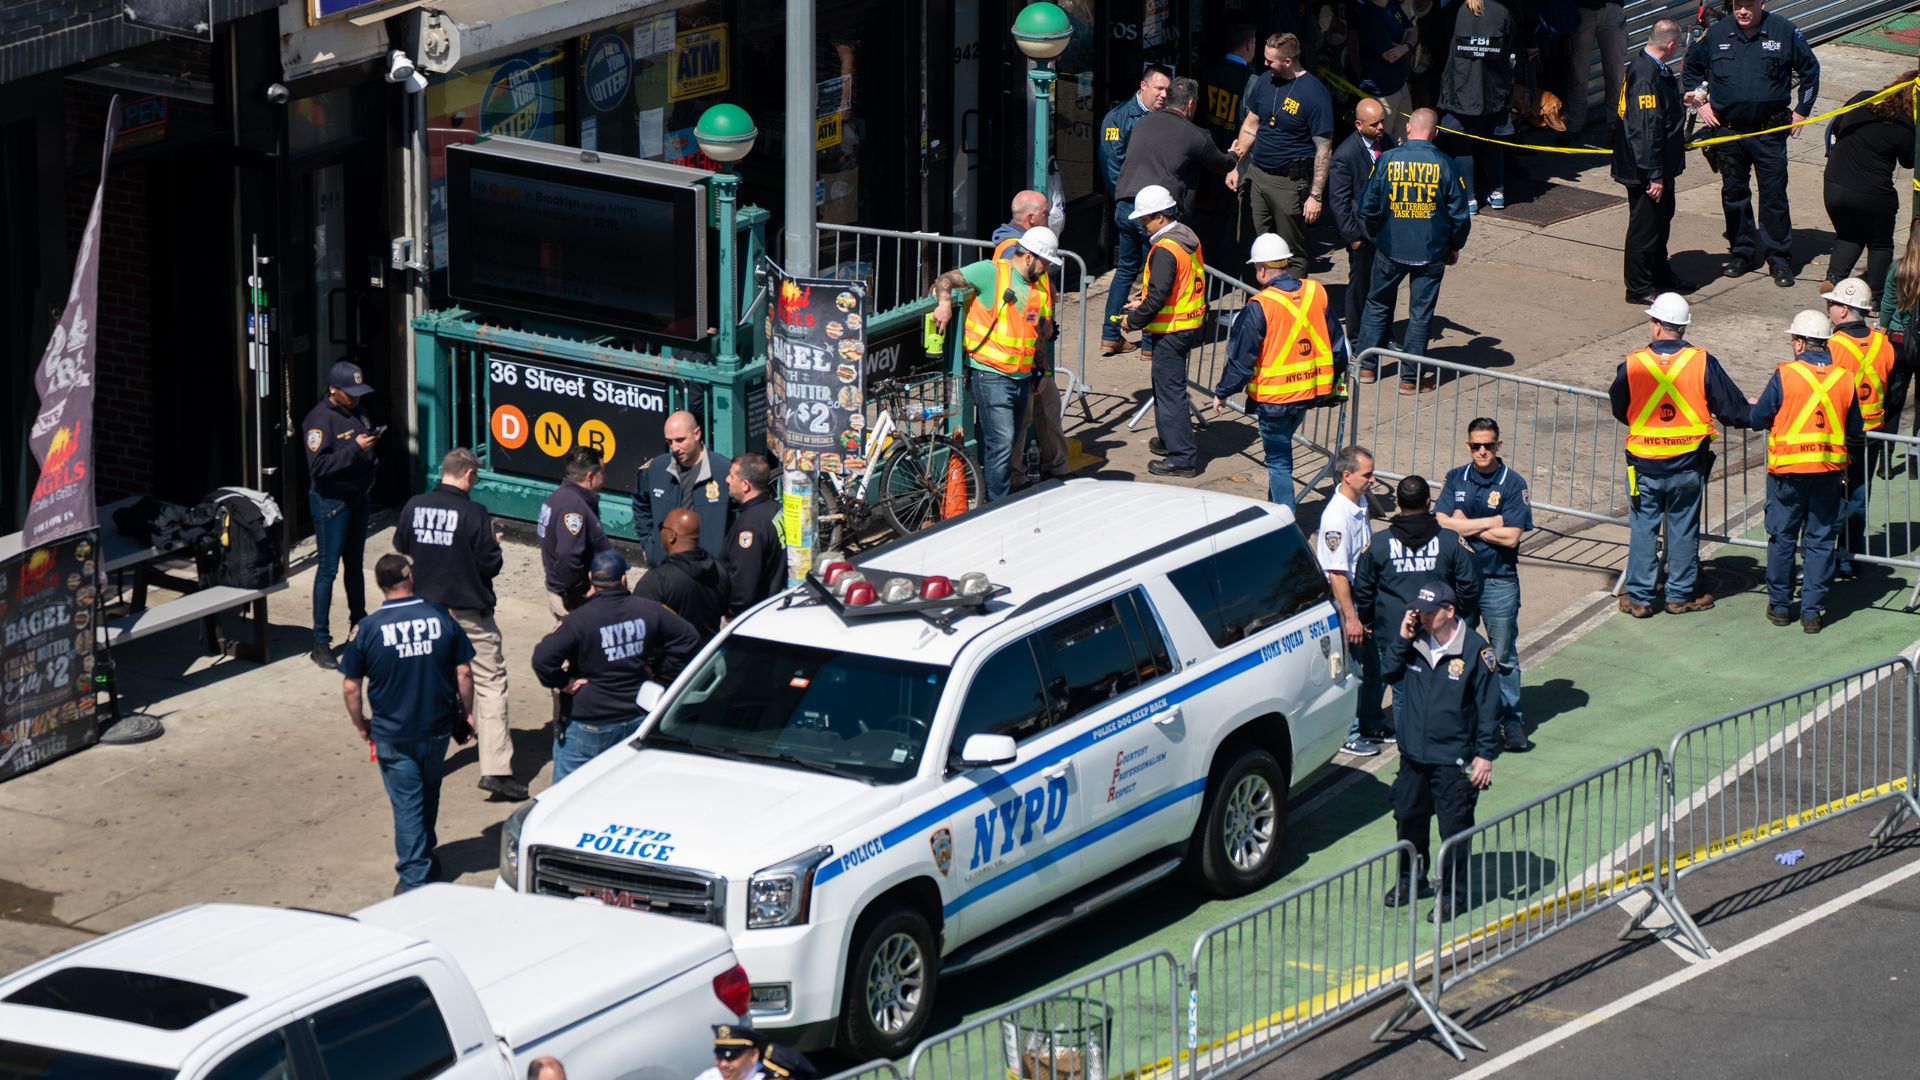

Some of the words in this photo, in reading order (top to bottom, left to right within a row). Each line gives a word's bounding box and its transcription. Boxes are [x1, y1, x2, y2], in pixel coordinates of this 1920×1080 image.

[603, 41, 620, 57] NEW
[1469, 34, 1490, 46] FBI
[1762, 41, 1781, 50] POLICE
[606, 53, 626, 72] YORK
[677, 41, 720, 82] ATM
[953, 42, 981, 64] 942
[511, 81, 536, 109] YORK
[591, 66, 628, 102] LOTTERY
[126, 99, 166, 126] PEN
[1207, 84, 1240, 125] FBI
[1283, 97, 1300, 112] FBI
[1638, 94, 1657, 110] FBI
[817, 120, 837, 142] ATM
[1104, 127, 1120, 141] FBI
[1387, 160, 1441, 184] FBI-NYPD
[535, 191, 580, 211] Brooklyn
[1388, 181, 1439, 203] JTTF
[1393, 210, 1410, 219] TASK
[1411, 211, 1432, 220] FORCE
[773, 336, 832, 372] BAGEL
[490, 361, 518, 387] 36
[524, 368, 586, 399] Street
[592, 380, 664, 413] Station
[1286, 372, 1303, 383] NYC
[786, 382, 832, 401] BUTTER
[501, 413, 520, 441] D
[545, 421, 562, 448] N
[1644, 436, 1662, 446] NYC
[1663, 435, 1692, 446] Transit
[1800, 444, 1816, 453] NYC
[32, 460, 86, 505] AGELS
[412, 506, 459, 532] NYPD
[414, 529, 454, 547] TARU
[1392, 556, 1437, 573] TARU
[4, 604, 70, 647] BAGEL
[380, 616, 442, 648] NYPD
[600, 618, 646, 649] NYPD
[395, 640, 433, 659] TARU
[604, 640, 645, 662] TARU
[1261, 639, 1282, 662] BOMB
[1281, 629, 1304, 653] SQUAD
[1092, 716, 1117, 741] POLICE
[1116, 713, 1133, 730] DOG
[1131, 704, 1149, 723] KEEP
[1149, 697, 1168, 717] BACK
[1112, 752, 1168, 785] PROFESSIONALISM
[1107, 782, 1137, 803] RESPECT
[602, 824, 672, 842] NYPD
[969, 776, 1069, 871] NYPD
[576, 833, 675, 862] POLICE
[842, 837, 883, 871] POLICE
